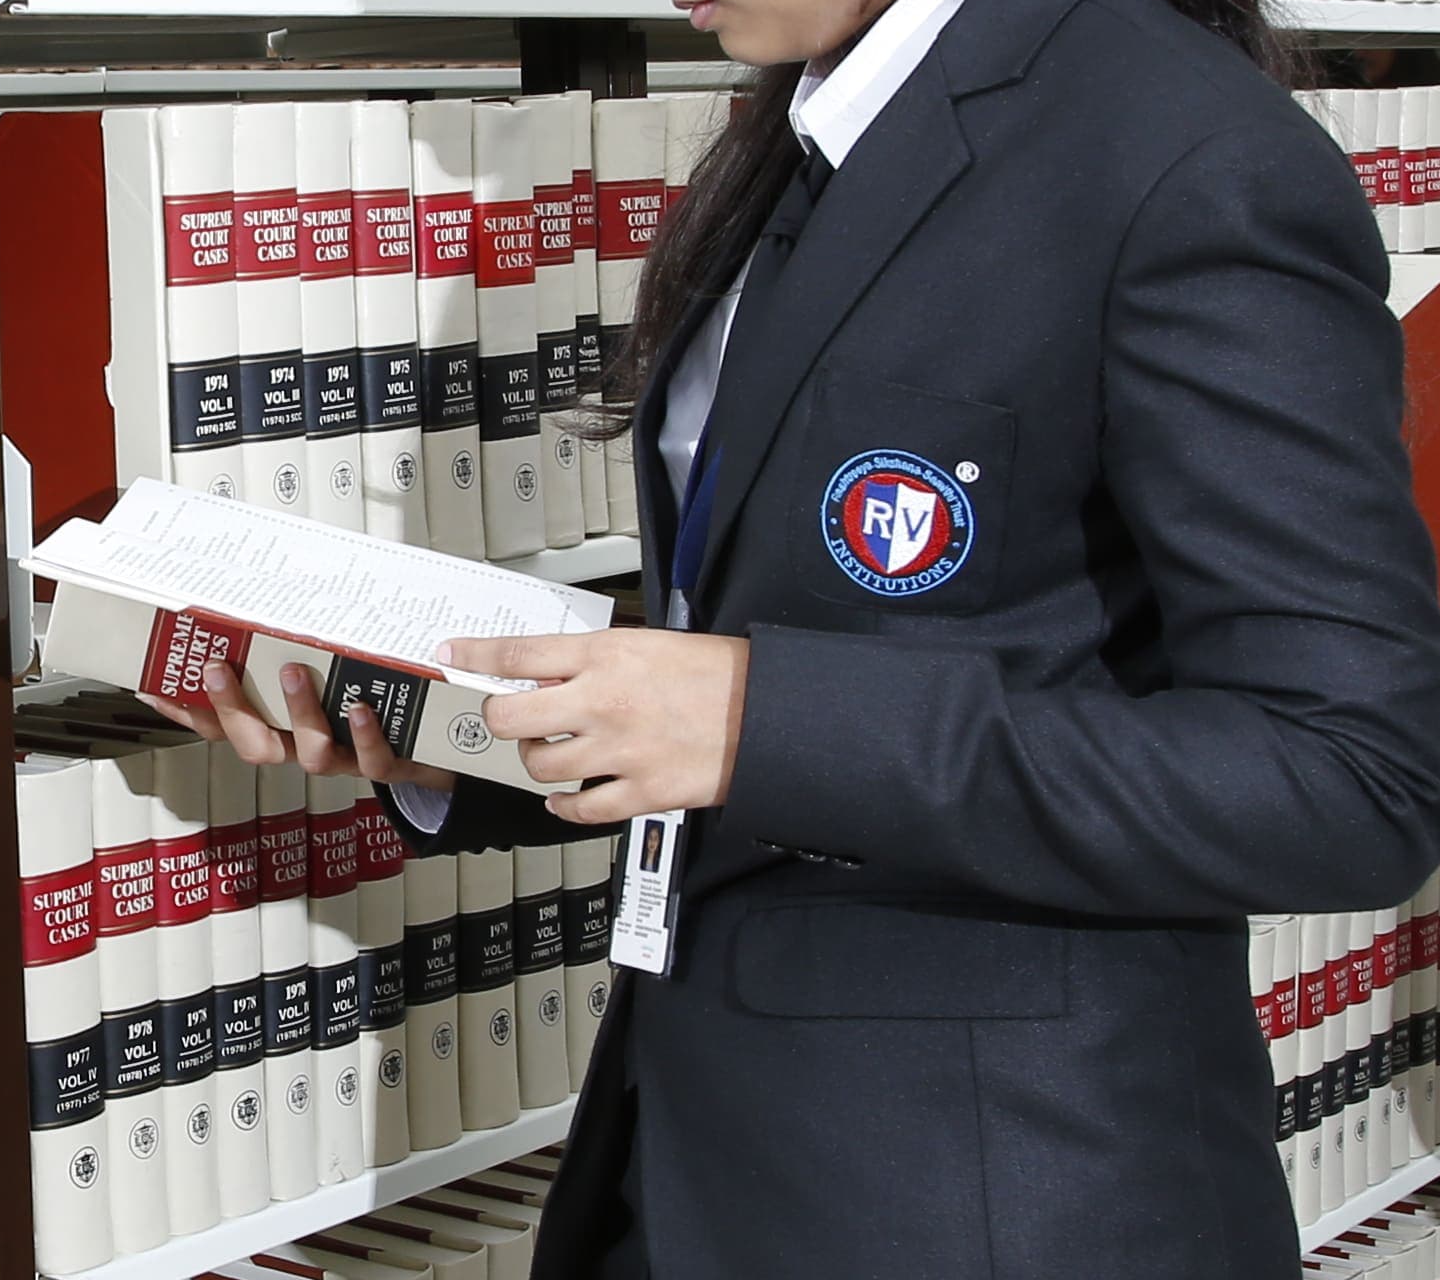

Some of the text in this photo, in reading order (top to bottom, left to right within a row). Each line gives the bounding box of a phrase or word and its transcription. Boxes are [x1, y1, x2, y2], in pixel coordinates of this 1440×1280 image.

[191, 229, 229, 248] COURT
[313, 226, 349, 244] COURT
[434, 226, 468, 243] COURT
[194, 248, 228, 267] CASES
[316, 244, 349, 261] CASES
[437, 244, 467, 260] CASES
[270, 367, 295, 384] 1974
[327, 365, 349, 382] 1974
[390, 359, 410, 375] 1975
[264, 388, 300, 405] VOL. III
[321, 386, 355, 403] VOL. IV
[387, 381, 413, 395] VOL. I
[862, 497, 930, 542] RV
[831, 538, 953, 591] INSTITUTIONS
[161, 614, 194, 697] SUPREME
[182, 626, 210, 692] COURT
[396, 683, 410, 706] SCC
[45, 901, 90, 927] COURT
[49, 920, 89, 945] CASES
[128, 1019, 153, 1040] 1978
[67, 1046, 90, 1068] 1977
[124, 1040, 156, 1060] VOL. I
[58, 1067, 97, 1090] VOL. IV
[57, 1090, 100, 1114] (1977) 4 SCC
